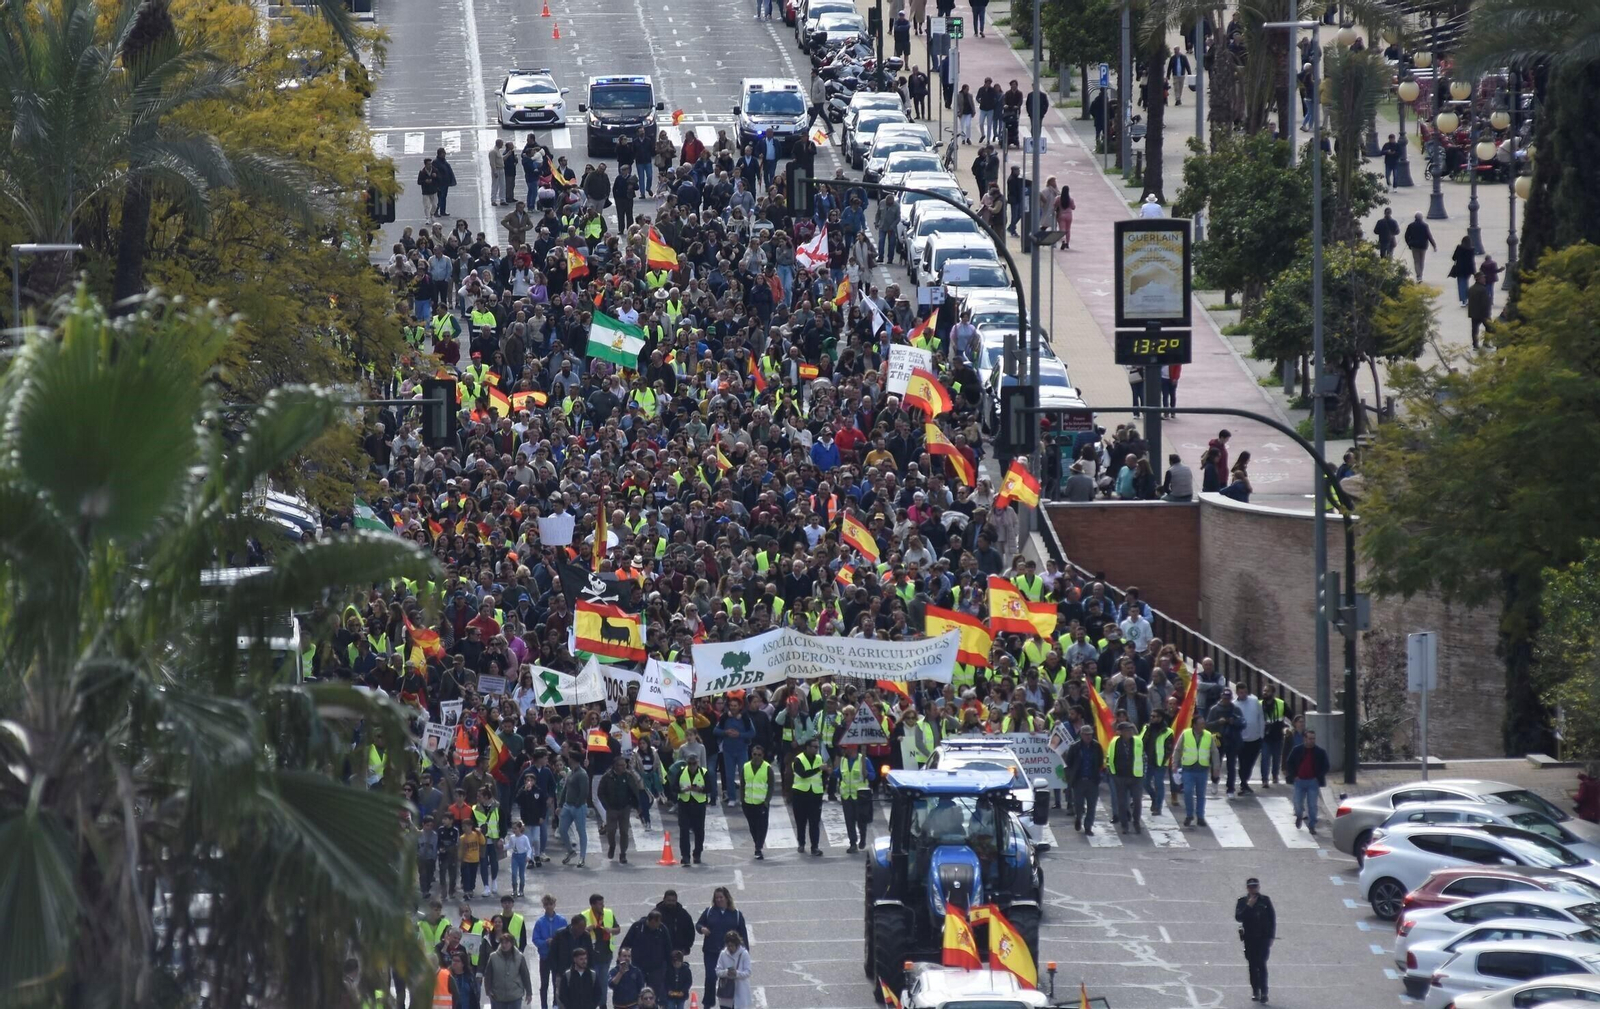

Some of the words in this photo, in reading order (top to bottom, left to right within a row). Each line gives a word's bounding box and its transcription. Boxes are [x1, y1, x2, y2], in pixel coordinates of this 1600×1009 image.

[1128, 234, 1179, 242] GUERLAIN
[827, 645, 845, 655] DE
[848, 638, 949, 658] AGRICULTORES
[767, 651, 836, 667] GANADEROS
[850, 654, 942, 671] EMPRESARIOS
[646, 676, 653, 684] LA
[705, 671, 764, 691] INDER
[847, 729, 858, 738] SE
[1025, 767, 1052, 775] DEMOS
